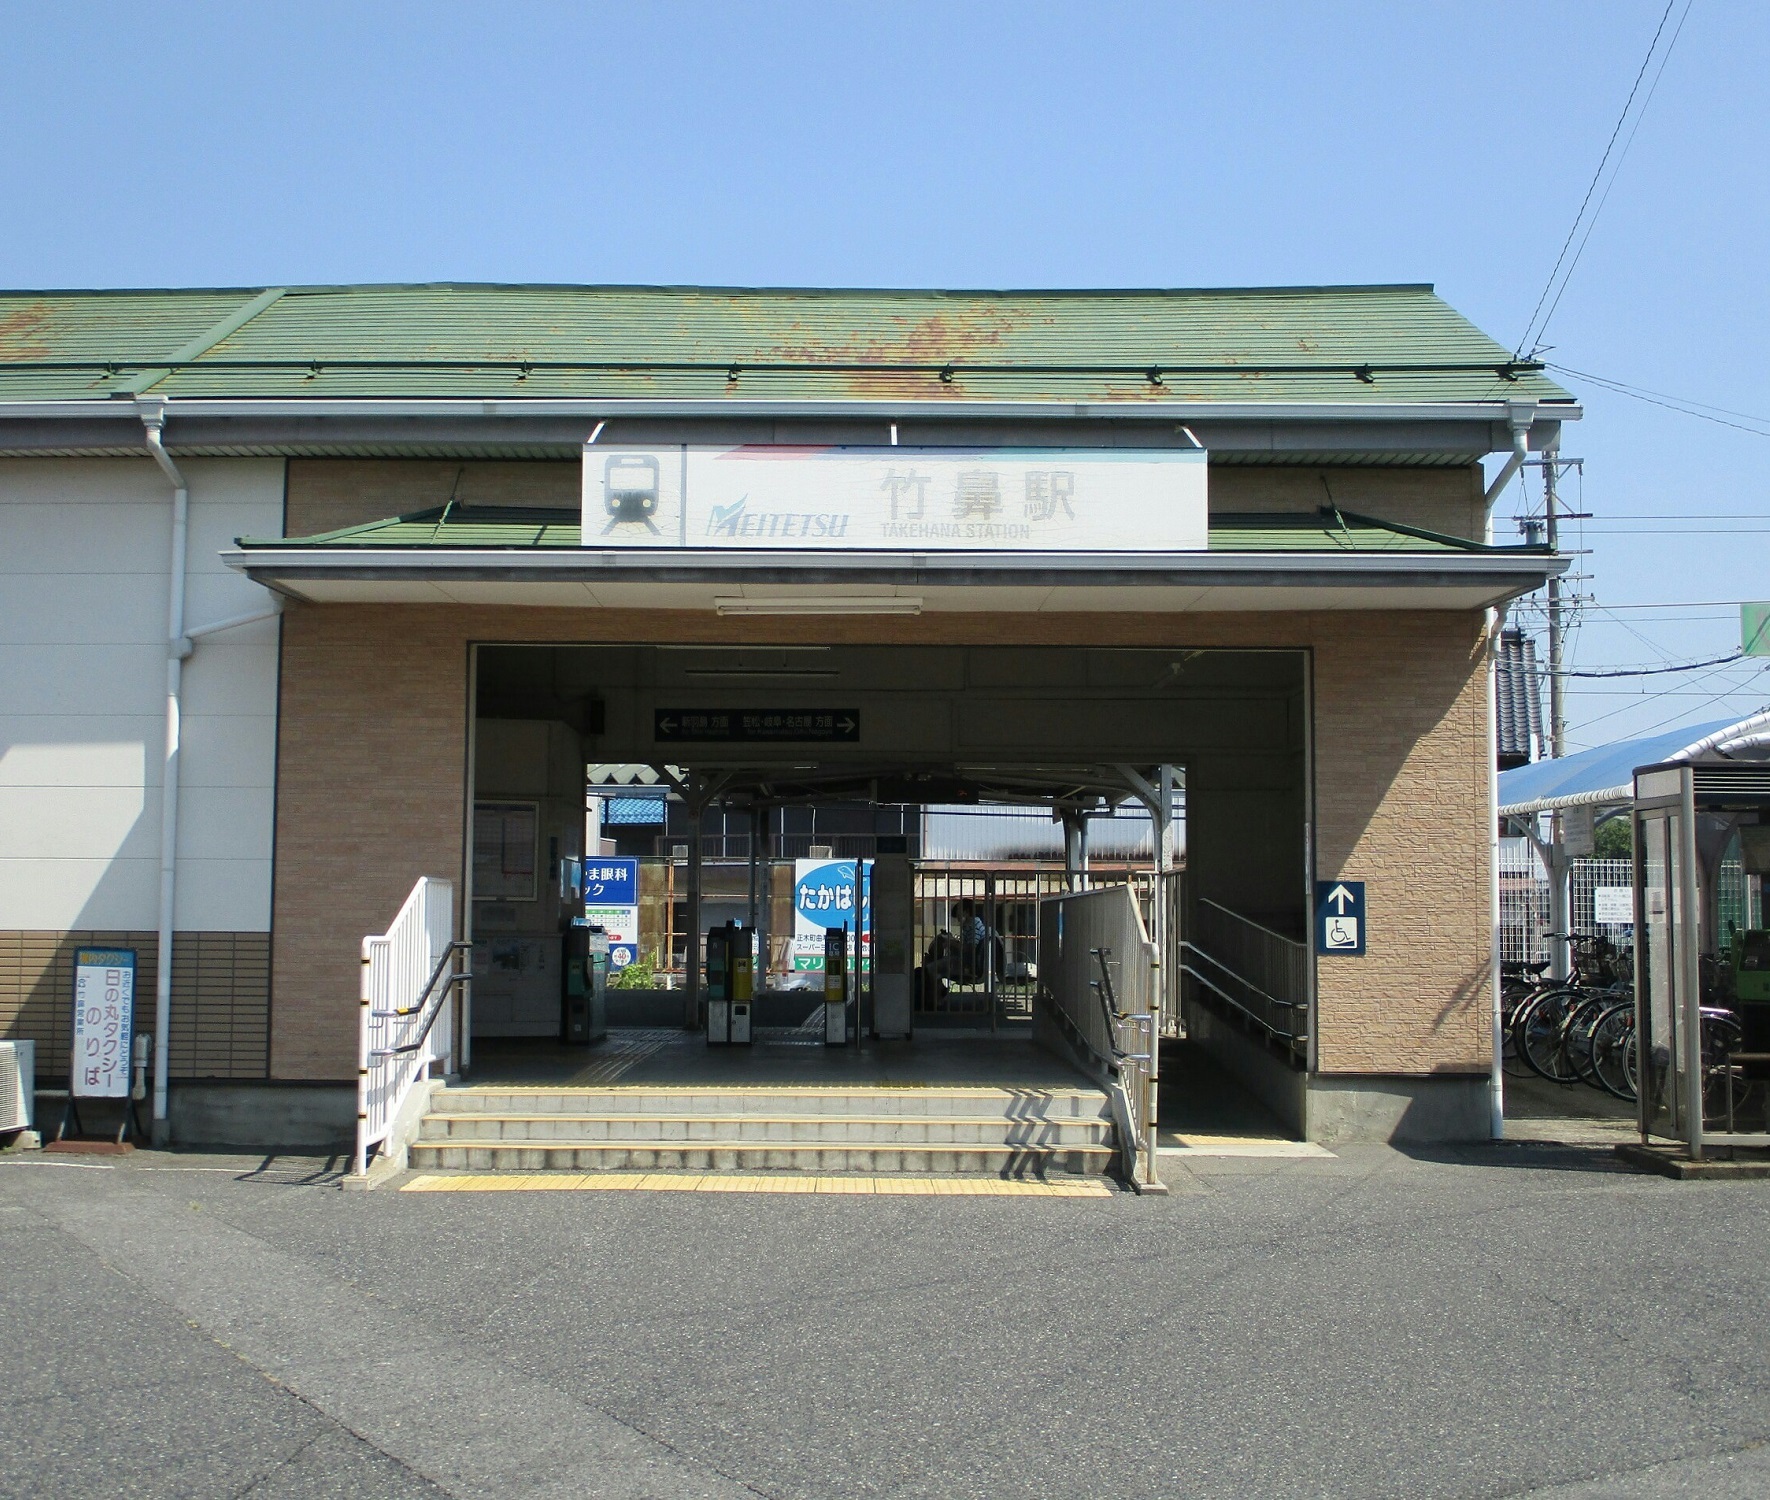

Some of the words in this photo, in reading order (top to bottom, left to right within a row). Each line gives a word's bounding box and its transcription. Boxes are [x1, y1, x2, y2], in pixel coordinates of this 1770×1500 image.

[880, 468, 1076, 521] 竹鼻駅
[706, 494, 849, 538] MEITETSU
[880, 523, 961, 539] TAKEHANA
[964, 523, 1030, 539] STATION
[711, 716, 729, 728] 方面
[815, 715, 833, 728] 方面
[585, 867, 628, 881] ま眼科
[102, 969, 121, 1088] 日の丸タクシー
[85, 1007, 102, 1086] のりば
